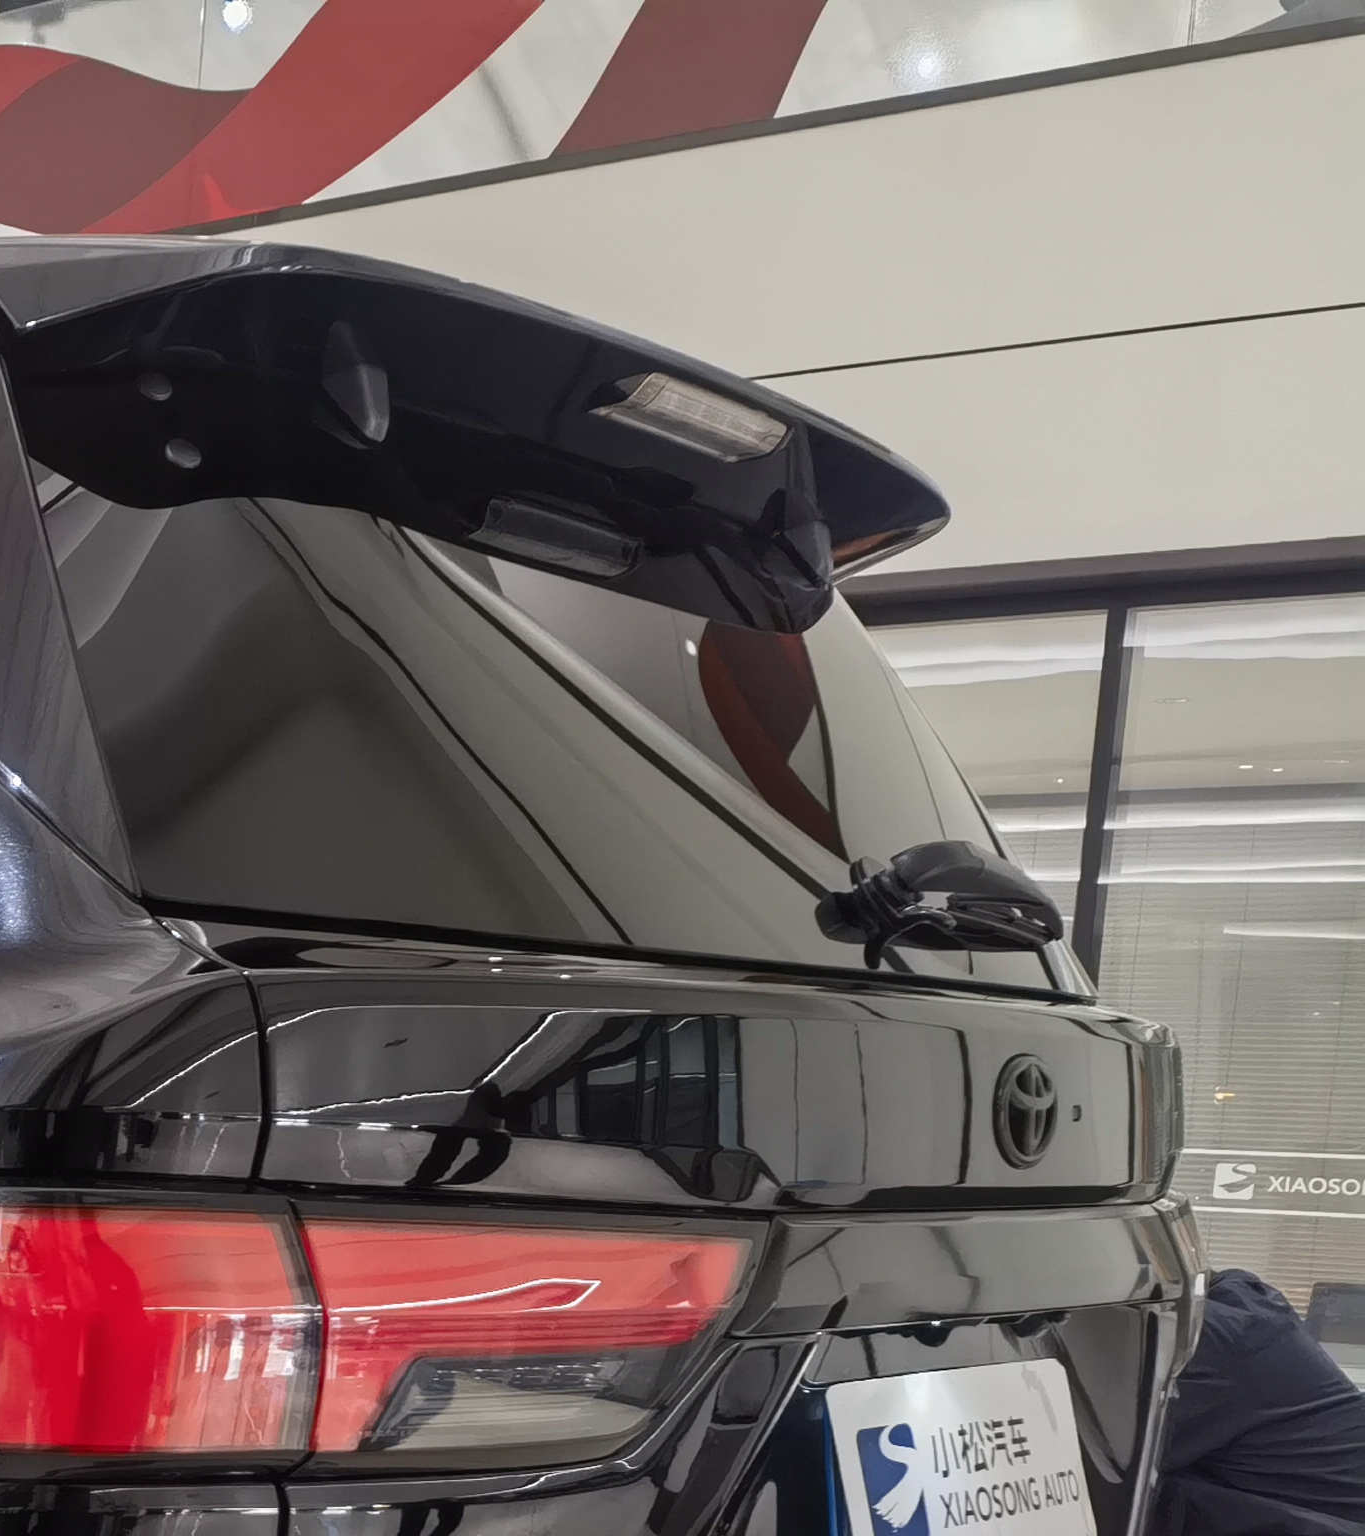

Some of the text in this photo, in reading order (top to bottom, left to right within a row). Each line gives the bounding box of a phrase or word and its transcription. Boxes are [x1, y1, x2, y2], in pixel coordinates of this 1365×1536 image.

[930, 1416, 1031, 1478] 小松汽车
[939, 1470, 1080, 1528] XIAOSONG AUTO
